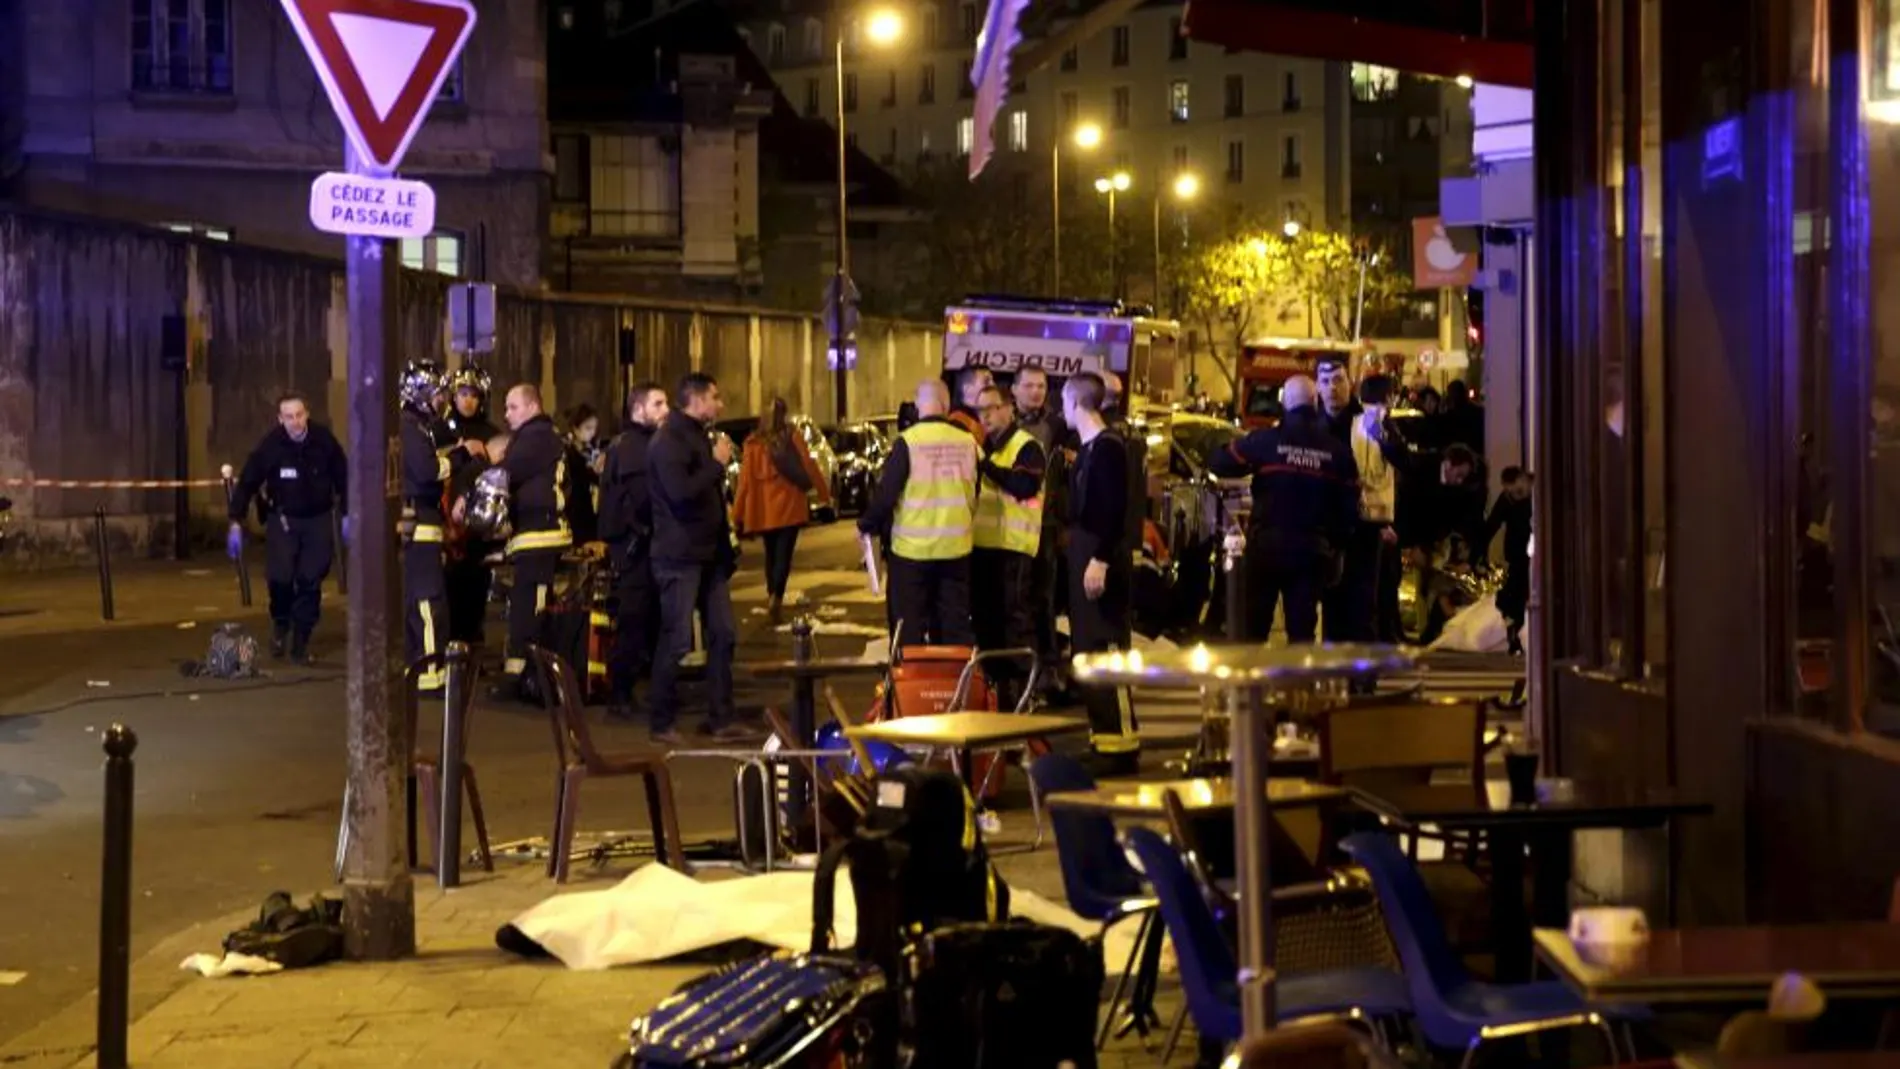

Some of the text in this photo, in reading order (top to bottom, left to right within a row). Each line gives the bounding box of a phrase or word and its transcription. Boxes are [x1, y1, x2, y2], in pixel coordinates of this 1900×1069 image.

[331, 184, 417, 207] CÉDEZ LE
[331, 205, 413, 228] PASSAGE
